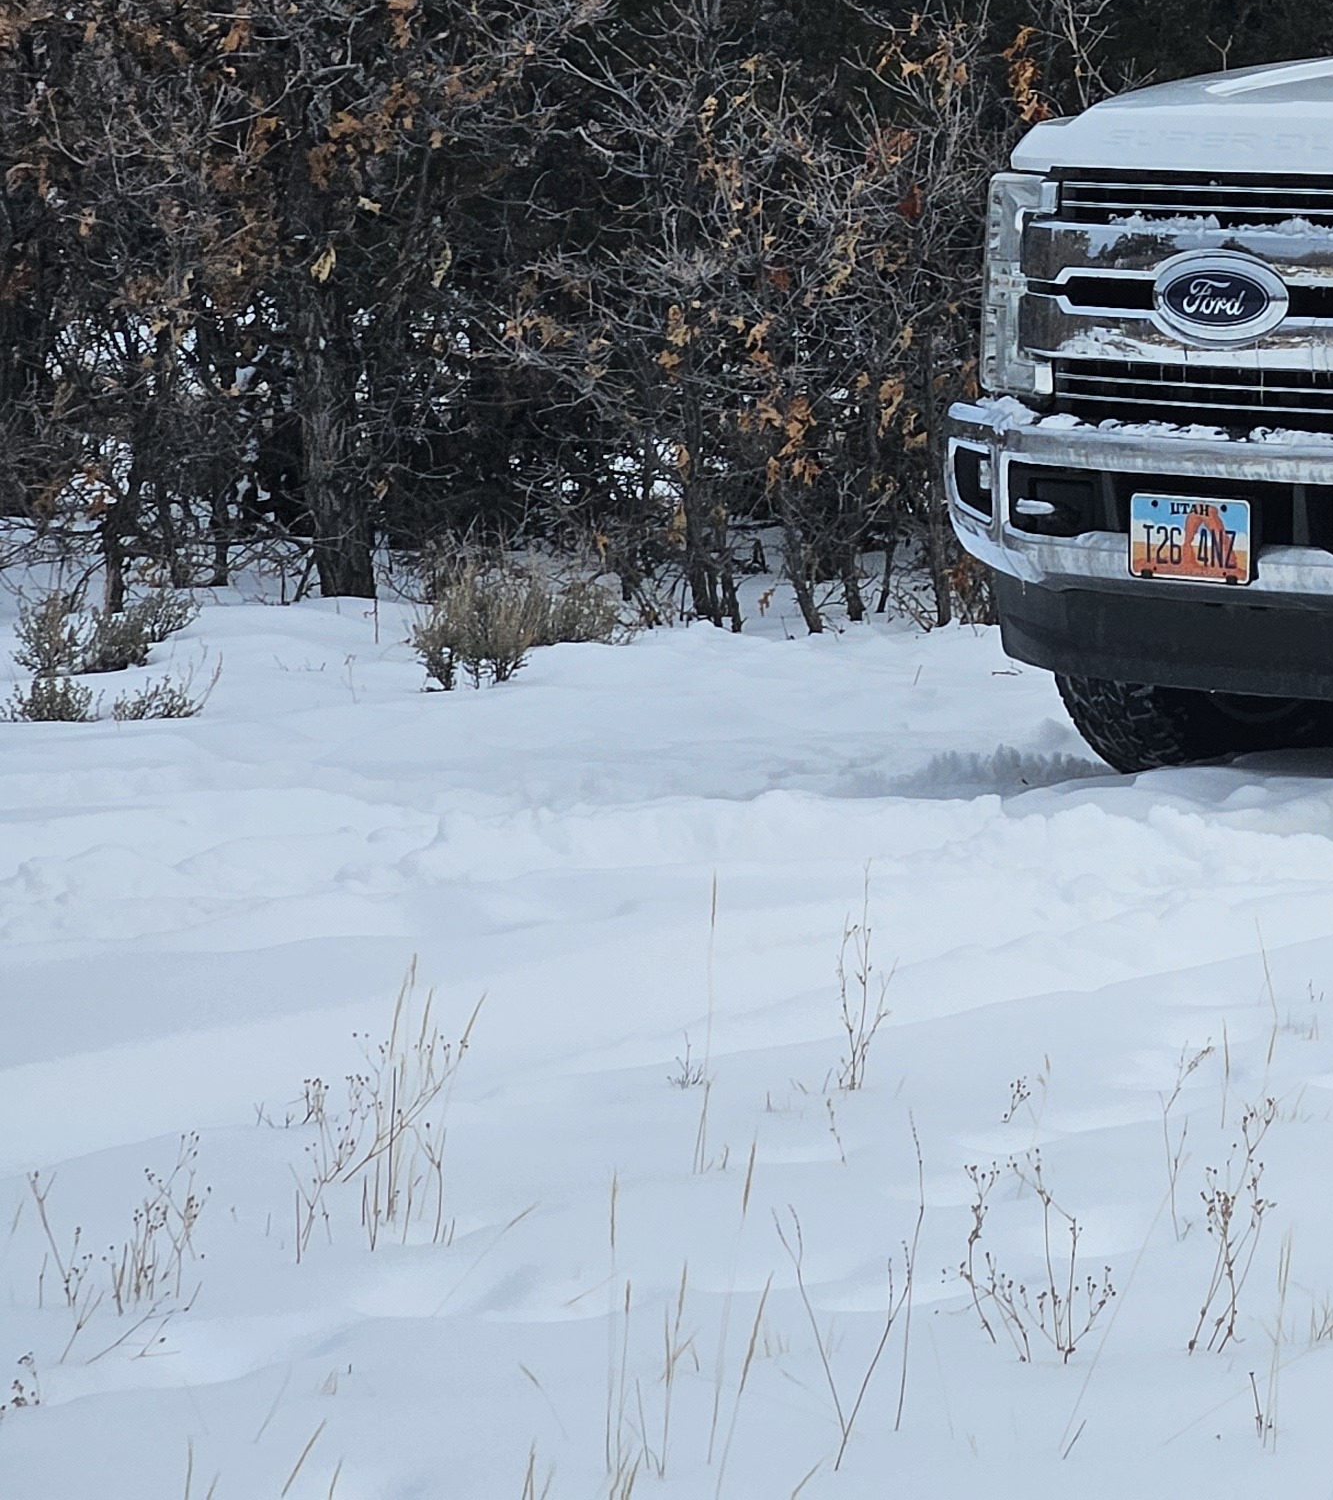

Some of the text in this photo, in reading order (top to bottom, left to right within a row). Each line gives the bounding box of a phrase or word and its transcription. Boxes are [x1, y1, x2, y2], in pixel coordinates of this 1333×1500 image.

[1182, 278, 1247, 316] Ford
[1170, 501, 1210, 516] UTAH
[1142, 523, 1182, 565] T26
